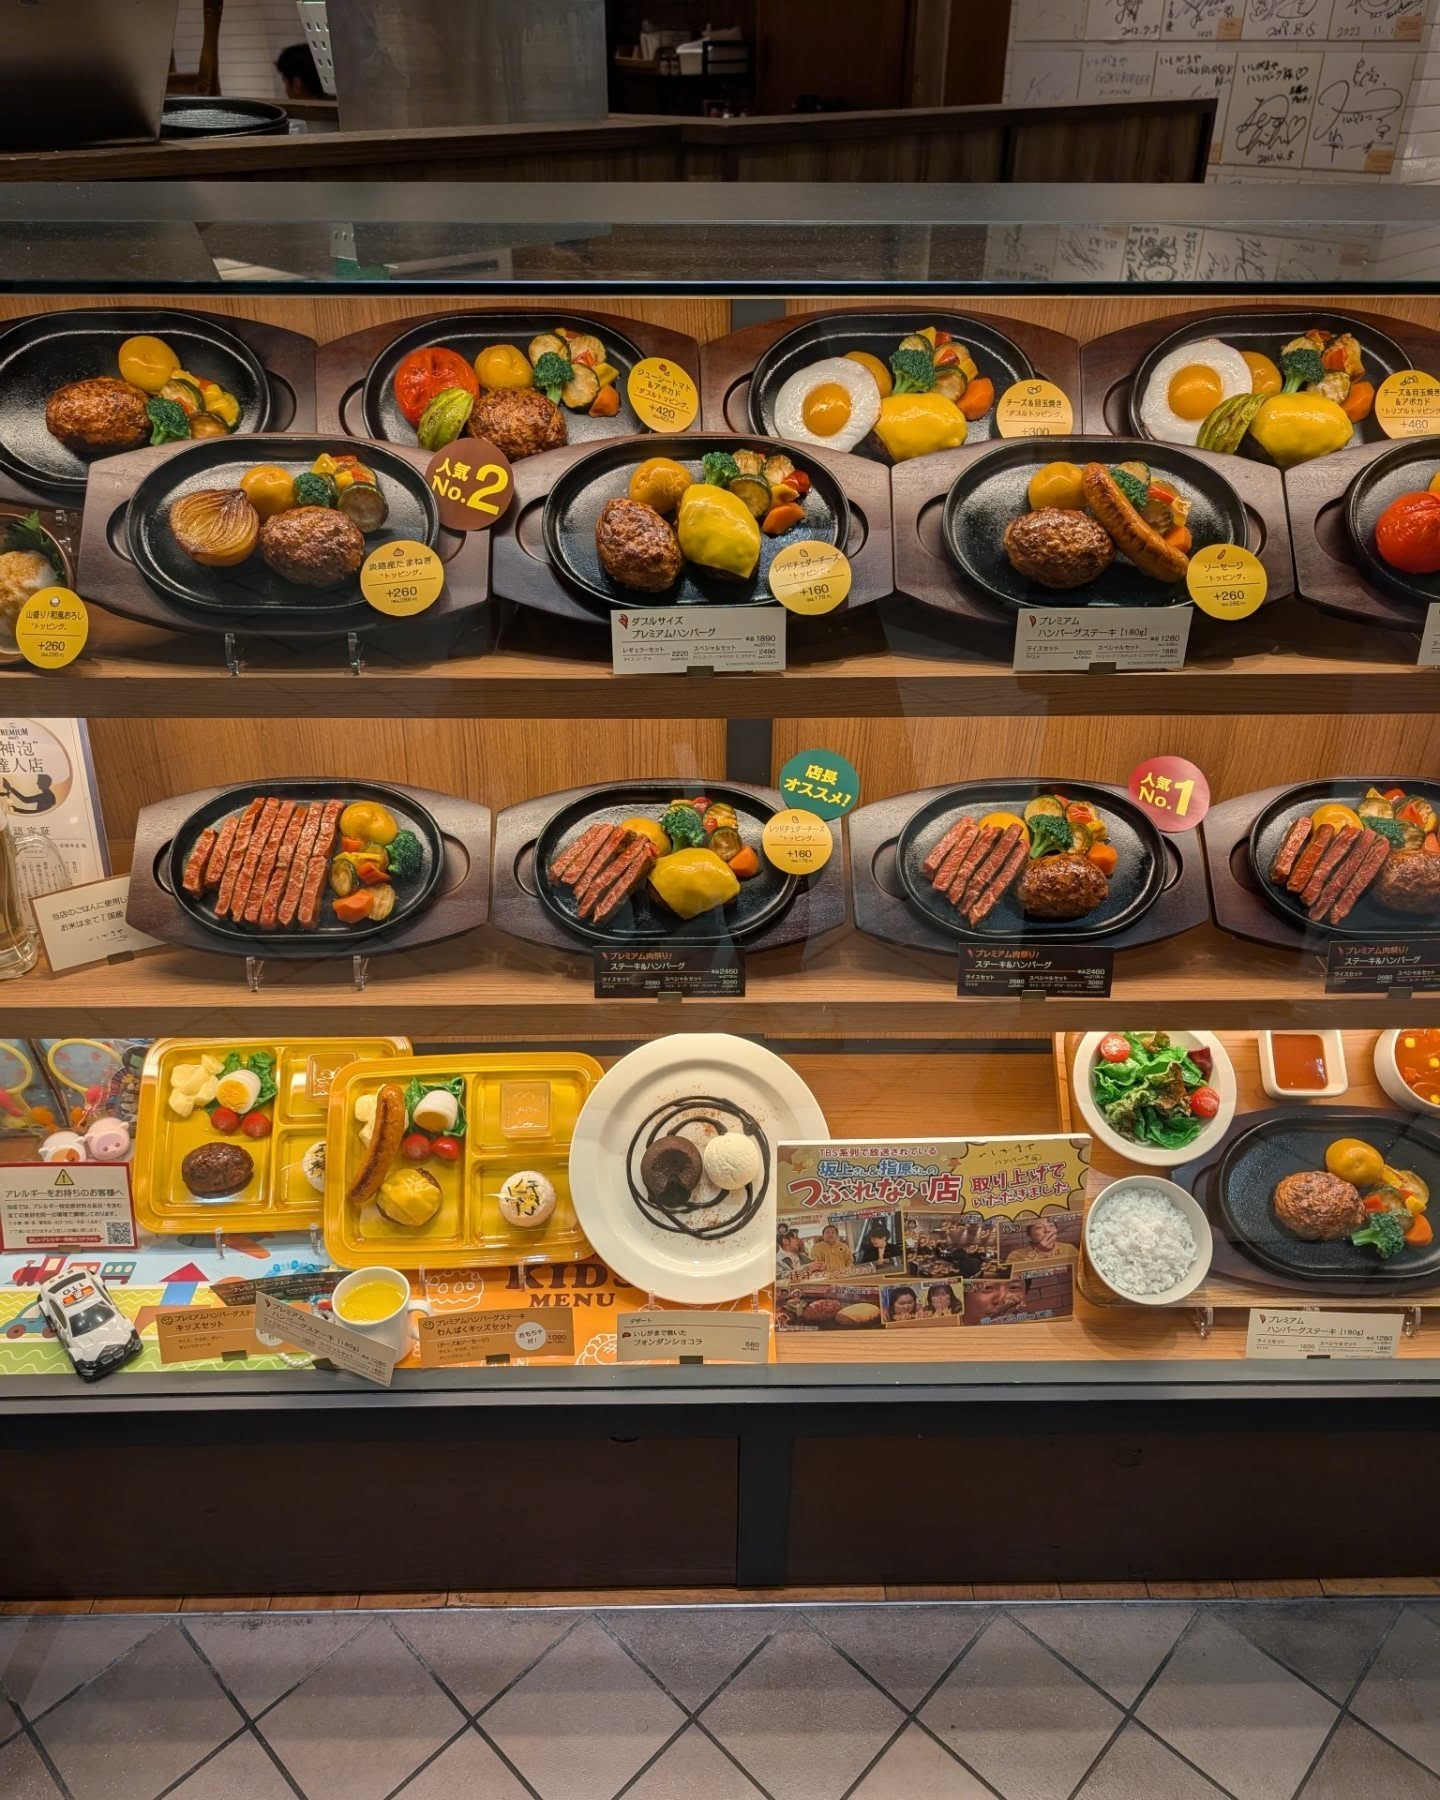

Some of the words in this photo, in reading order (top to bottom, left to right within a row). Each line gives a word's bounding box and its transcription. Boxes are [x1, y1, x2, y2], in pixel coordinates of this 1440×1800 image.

[1006, 398, 1062, 409] チーズ&目玉焼き
[649, 403, 676, 419] +420
[1400, 420, 1429, 429] +460
[435, 457, 471, 482] 人気
[1204, 561, 1244, 572] ソーセージ
[386, 586, 417, 598] +260
[800, 583, 829, 596] +160
[1213, 590, 1245, 601] +260
[632, 616, 684, 627] ダブルサイズ
[1039, 616, 1080, 627] プレミアム
[632, 627, 717, 640] プレミアムハンバーグ
[756, 634, 776, 643] 1890
[1038, 628, 1117, 638] ハンバーグステーキ
[1161, 634, 1180, 643] 1280
[38, 640, 65, 652] +260
[805, 764, 838, 786] 店長
[1140, 771, 1173, 793] 人気
[783, 777, 852, 808] オススメ!
[786, 849, 812, 858] +160
[975, 960, 1053, 969] ステーキ&ハンバーグ
[1344, 955, 1421, 966] ステーキ&ハンバーグ
[610, 962, 686, 971] ステーキ&ハンバーグ
[819, 1147, 938, 1158] TBS系列で放送されている
[970, 1161, 1067, 1194] 取り上げて
[4, 1188, 124, 1199] アレルギーをお持ちのお客様へ
[788, 1172, 963, 1208] つぶれない店
[529, 1292, 616, 1308] MENU
[436, 1313, 526, 1328] プレミアムハンバーグステーキ
[1268, 1315, 1305, 1325] プレミアム
[176, 1320, 224, 1332] キッズセット
[437, 1322, 513, 1336] わんぱくキッズセット
[1267, 1325, 1337, 1335] ハンバーグステーキ
[518, 1328, 543, 1339] おもちゃ
[633, 1329, 687, 1337] いしがまで焼いた
[633, 1338, 703, 1347] フォンダンショコラ
